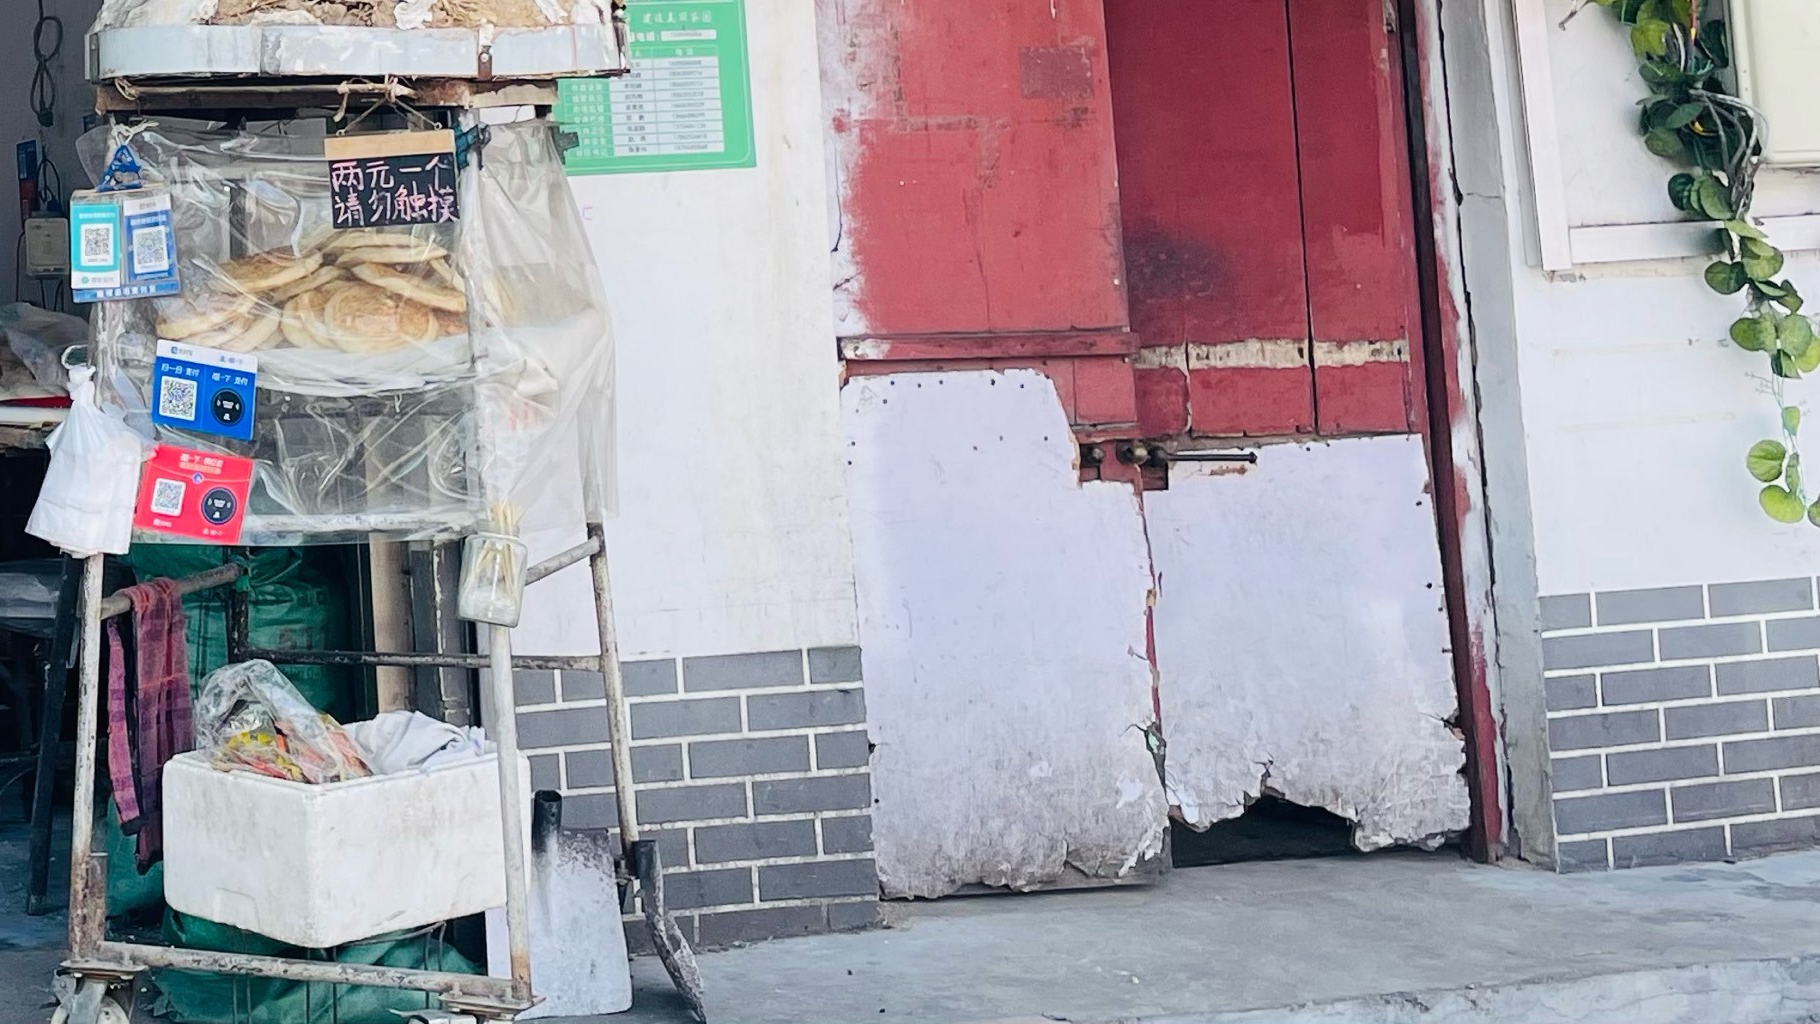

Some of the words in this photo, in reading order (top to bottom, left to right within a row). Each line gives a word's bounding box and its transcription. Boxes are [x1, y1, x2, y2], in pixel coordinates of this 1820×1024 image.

[331, 155, 452, 192] 两元一个
[334, 180, 459, 227] 请勿触摸
